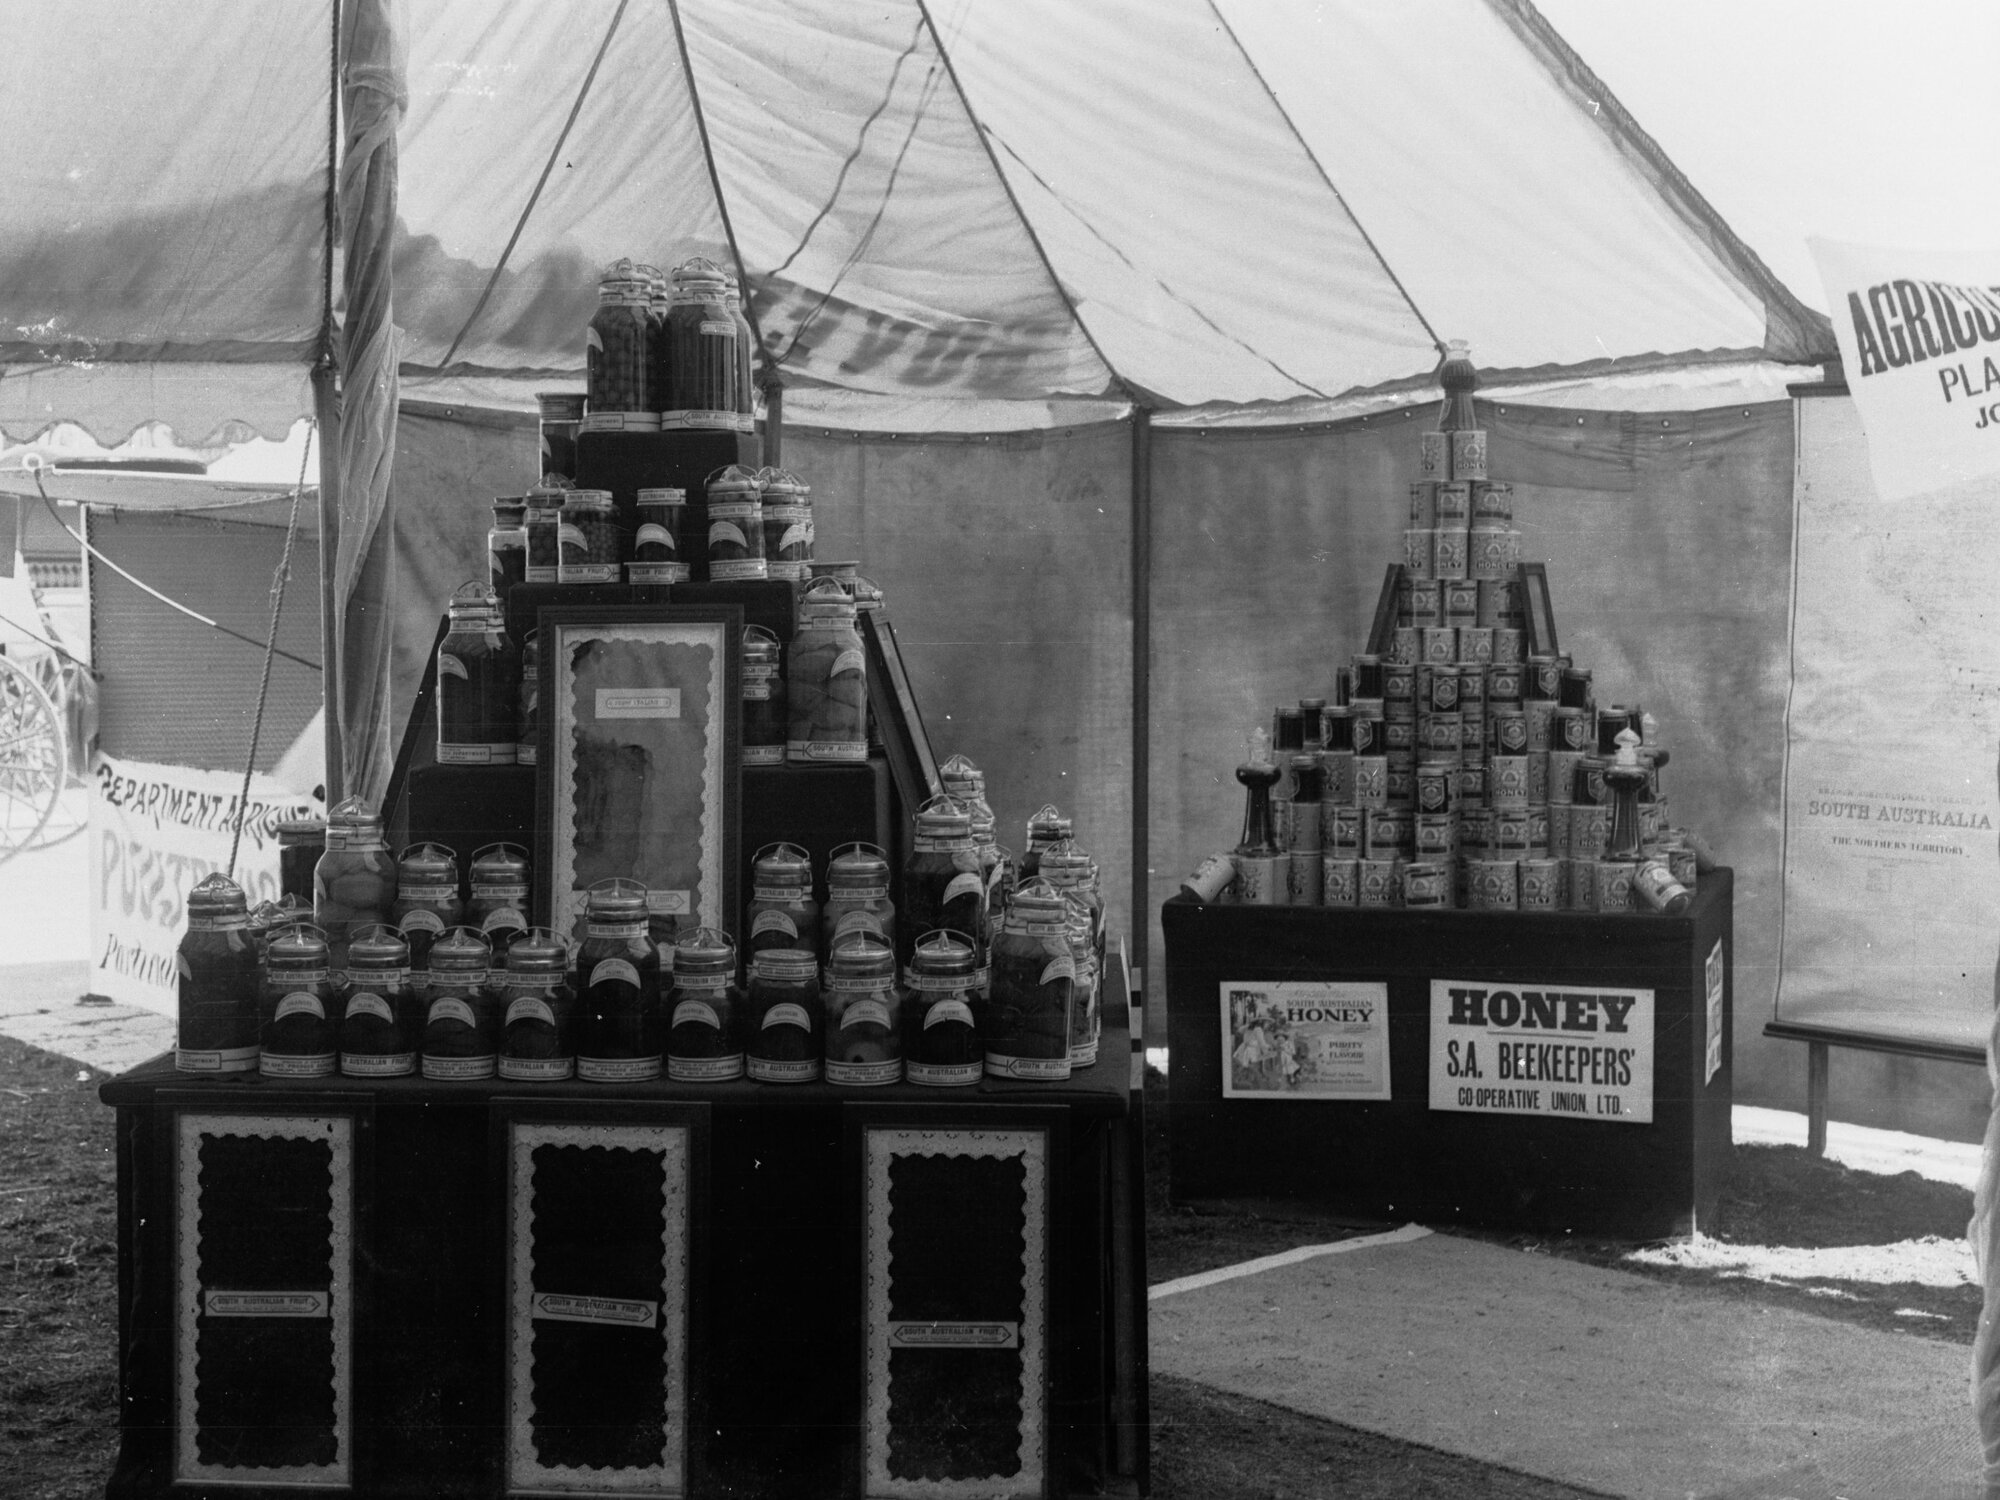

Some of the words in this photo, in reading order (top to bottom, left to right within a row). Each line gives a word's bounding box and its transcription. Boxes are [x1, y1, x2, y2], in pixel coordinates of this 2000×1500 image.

[1847, 278, 2000, 377] AGRICU
[1808, 800, 1870, 820] SOUTH
[1876, 805, 1992, 830] AUSTRALIA
[1911, 843, 1963, 855] TERRITORY
[1287, 1008, 1375, 1022] HONEY
[1448, 988, 1636, 1033] HONEY
[1329, 1041, 1363, 1049] PURITY
[1447, 1039, 1483, 1079] S.A.
[1498, 1041, 1636, 1087] BEEKEEPERS'
[1597, 1094, 1623, 1115] LTD.
[575, 1299, 617, 1310] AUSTRALIAN
[930, 1327, 974, 1335] AUSTRALIAN
